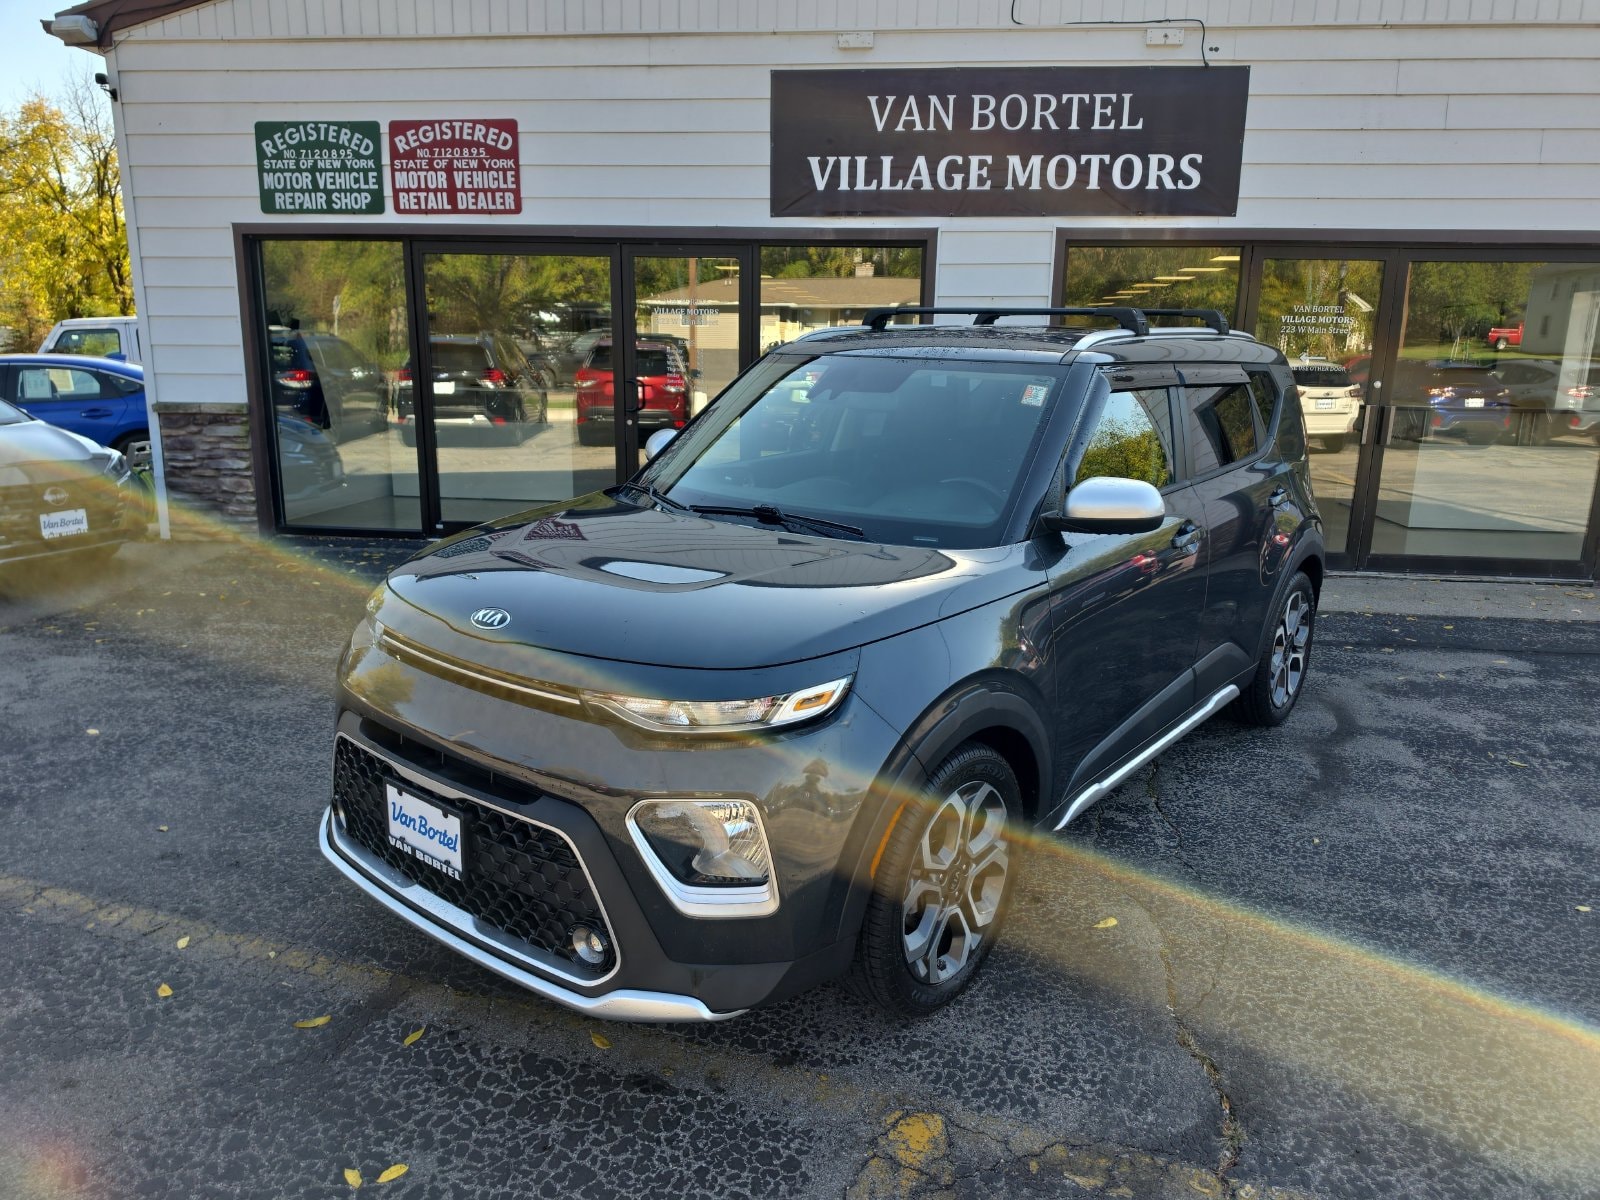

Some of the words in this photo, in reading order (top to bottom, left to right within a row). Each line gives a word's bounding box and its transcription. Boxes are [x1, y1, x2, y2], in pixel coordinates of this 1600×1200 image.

[867, 94, 956, 132] VAN
[970, 93, 1144, 131] BORTEL
[261, 123, 374, 157] REGISTERED
[393, 121, 513, 154] REGISTERED
[300, 149, 353, 159] 7120895
[433, 147, 486, 157] 7120895
[263, 159, 297, 169] STATE
[299, 159, 314, 169] OF
[317, 159, 340, 169] NEW
[346, 159, 375, 169] YORK
[393, 159, 429, 169] STATE
[433, 159, 449, 169] OF
[453, 159, 478, 169] NEW
[482, 159, 515, 169] YORK
[807, 154, 992, 191] VILLAGE
[1004, 153, 1203, 191] MOTORS
[263, 172, 312, 190] MOTOR
[315, 171, 378, 189] VEHICLE
[394, 171, 448, 189] MOTOR
[453, 171, 516, 189] VEHICLE
[275, 192, 327, 209] REPAIR
[331, 192, 371, 209] SHOP
[399, 192, 451, 209] RETAIL
[457, 192, 515, 210] DEALER
[654, 307, 685, 315] VILLAGE
[1293, 305, 1310, 313] VAN
[1312, 305, 1345, 313] BORTEL
[1281, 315, 1317, 323] VILLAGE
[1318, 316, 1354, 324] MOTORS
[1328, 326, 1351, 334] Street
[474, 609, 503, 625] KIA
[388, 835, 412, 854] VAN
[415, 849, 461, 881] BORTEL
